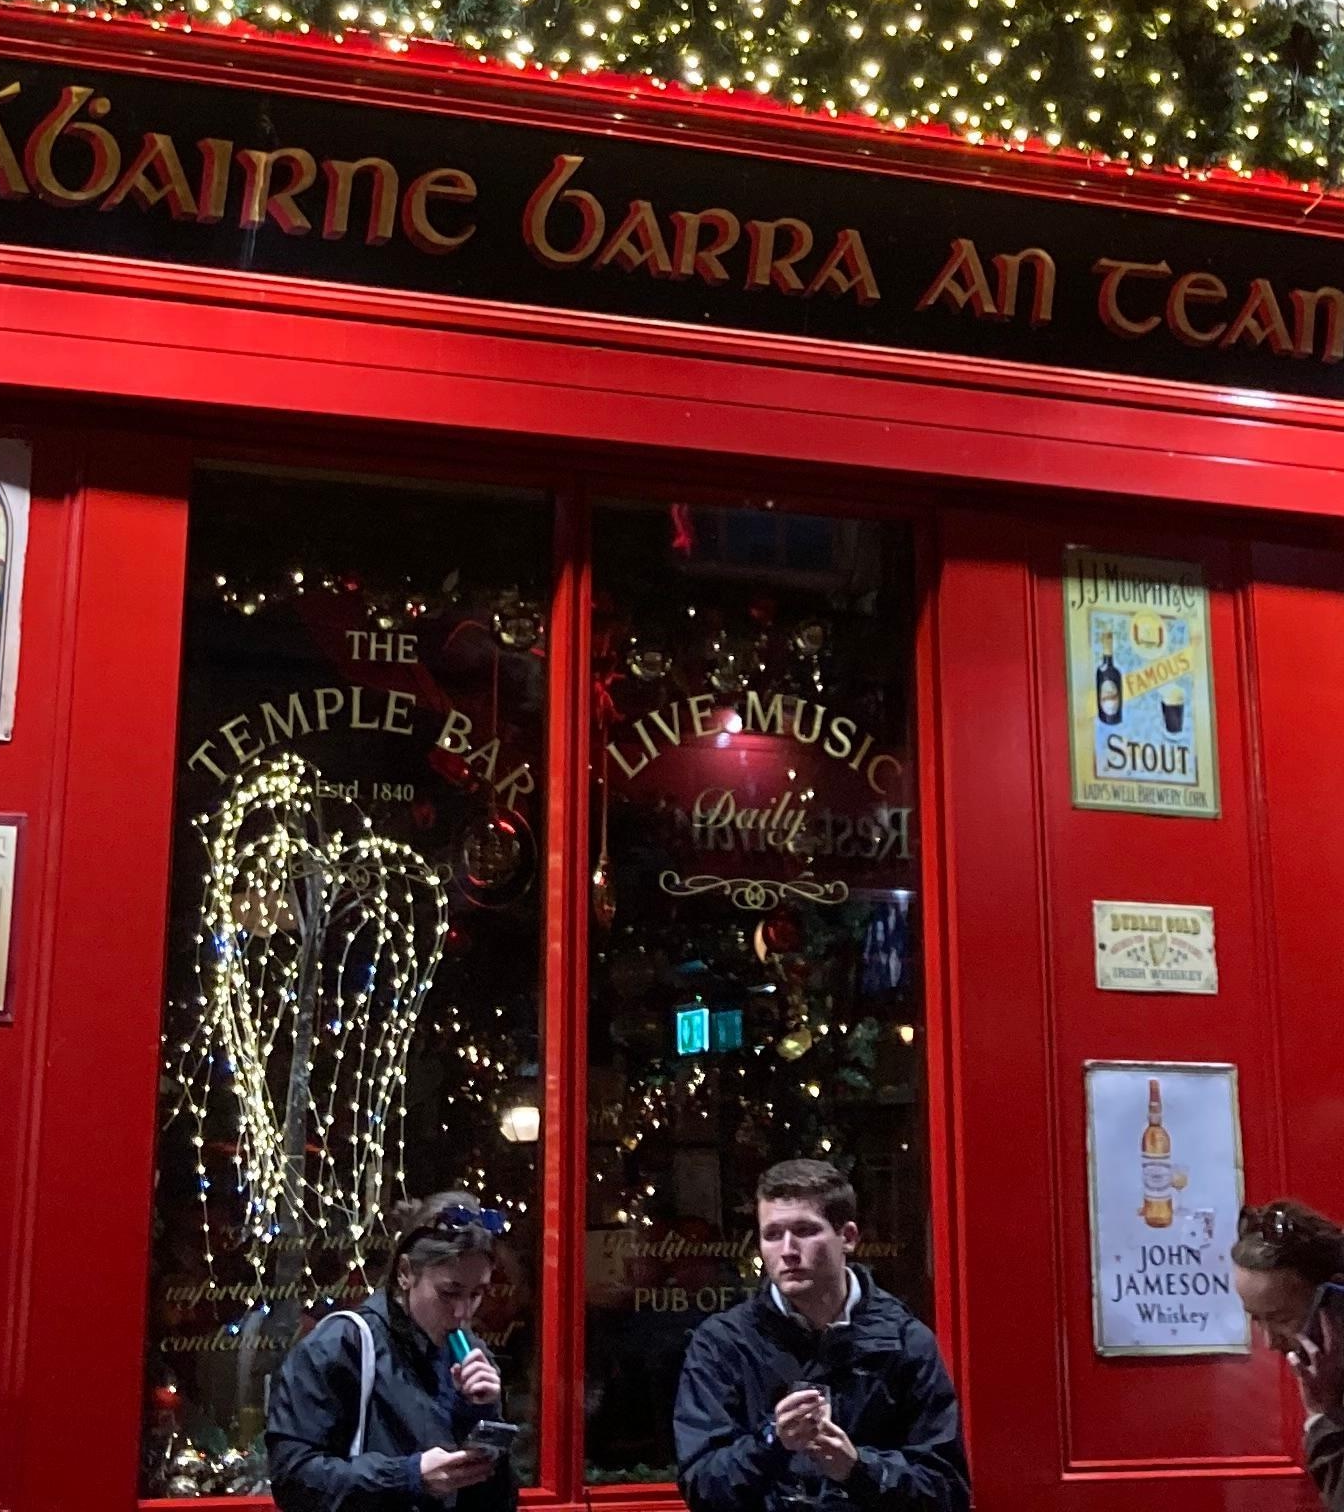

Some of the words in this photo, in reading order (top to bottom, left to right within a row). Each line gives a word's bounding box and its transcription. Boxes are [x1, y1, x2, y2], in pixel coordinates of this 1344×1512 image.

[345, 630, 419, 664] THE
[1126, 652, 1190, 696] FAMOUS
[188, 686, 417, 785] TEMPLE
[436, 708, 534, 813] BAR
[607, 693, 724, 779] LIVE
[746, 691, 903, 794] MUSIC
[1107, 734, 1188, 775] STOUT
[373, 782, 415, 801] 1840
[692, 787, 806, 846] Daily
[1138, 1245, 1203, 1274] JOHN
[634, 1288, 690, 1312] PUB
[696, 1288, 734, 1312] OF
[1112, 1273, 1231, 1303] JAMESON
[1136, 1303, 1210, 1331] Whiskey
